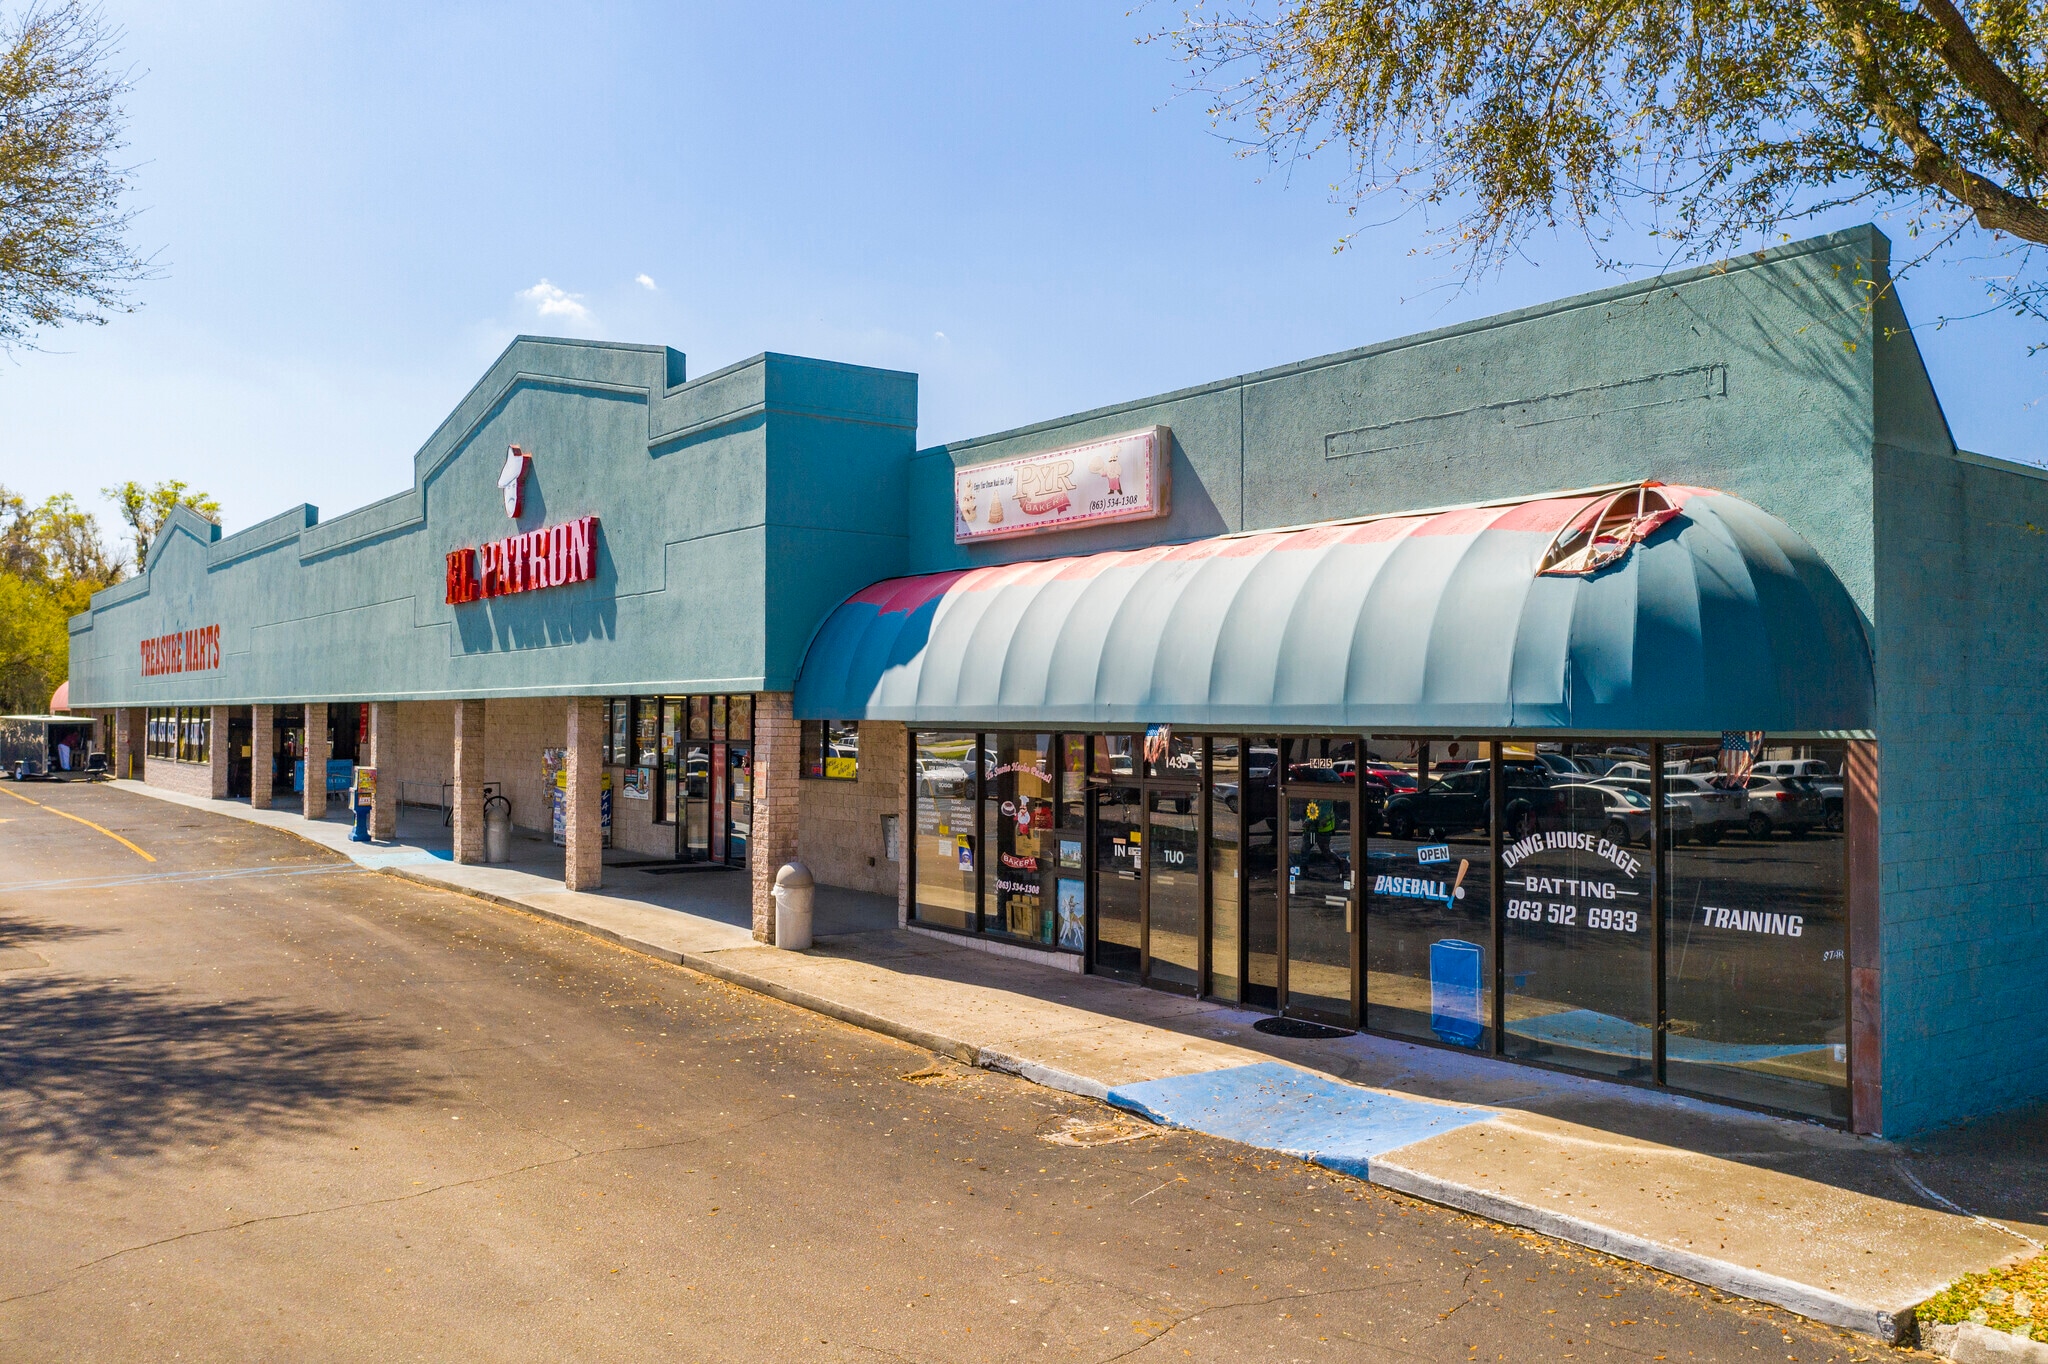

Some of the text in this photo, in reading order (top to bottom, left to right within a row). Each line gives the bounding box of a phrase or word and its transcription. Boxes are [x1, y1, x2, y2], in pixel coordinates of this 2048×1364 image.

[1012, 459, 1077, 500] PYR
[1025, 493, 1065, 511] BAKERY
[1089, 494, 1138, 513] (863) 534-1308
[446, 515, 599, 605] EL PATRON
[140, 623, 220, 676] TREASURE MARTS
[1165, 756, 1188, 769] 1435
[1310, 758, 1332, 769] 1425
[1003, 855, 1035, 868] BAKERY
[1114, 844, 1126, 858] IN
[1419, 847, 1448, 861] OPEN
[1501, 831, 1641, 879] DAWG HOUSE CAGE
[995, 879, 1040, 895] (863) 534-1308
[1374, 874, 1450, 901] BASEBALL
[1526, 876, 1616, 900] BATTING
[1506, 899, 1638, 933] 863 512 6933
[1702, 906, 1804, 937] TRAINING
